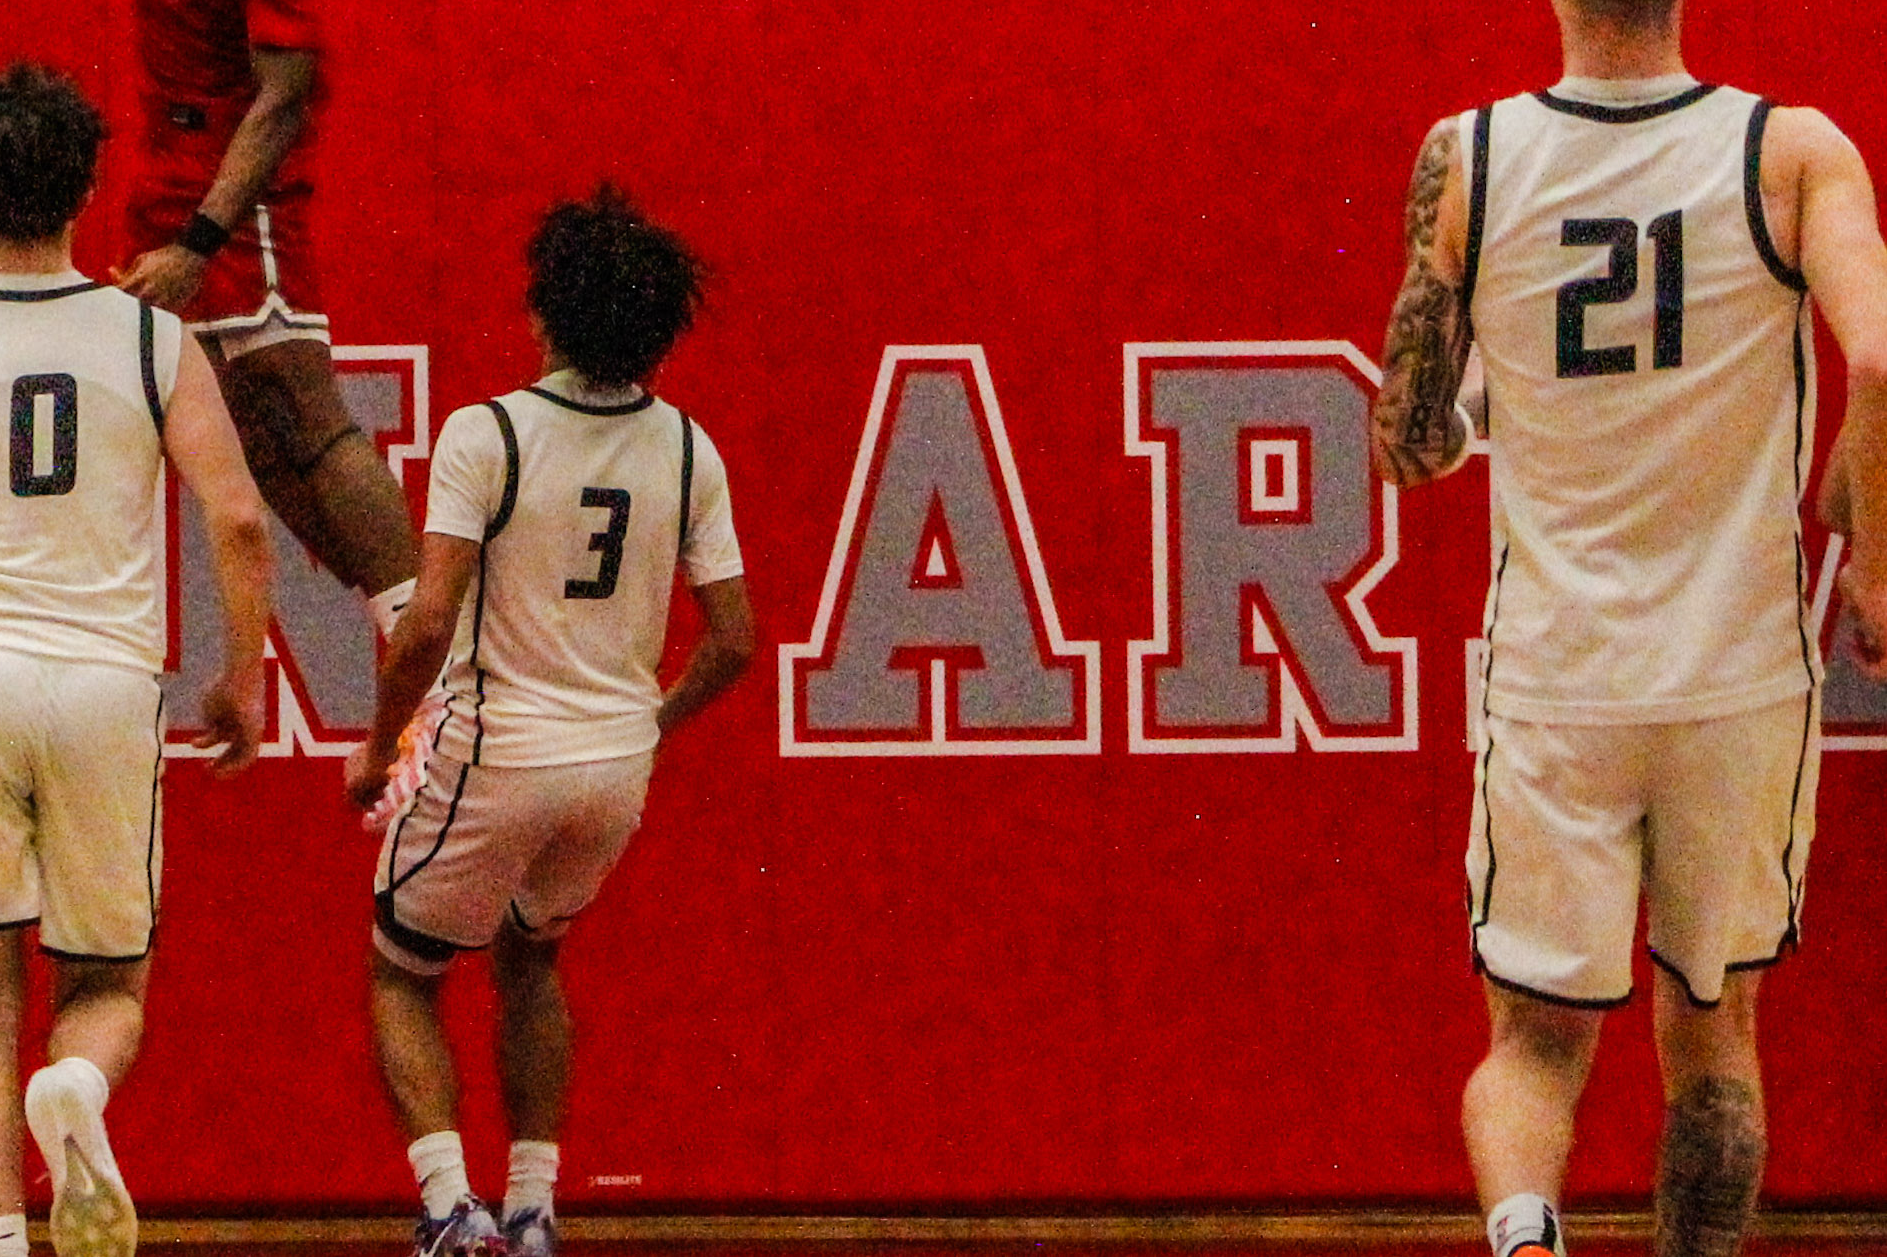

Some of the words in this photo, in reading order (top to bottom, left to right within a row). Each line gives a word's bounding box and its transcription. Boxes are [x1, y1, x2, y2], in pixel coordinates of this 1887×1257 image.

[1555, 209, 1683, 379] 21
[9, 372, 77, 496] 0
[564, 486, 631, 600] 3
